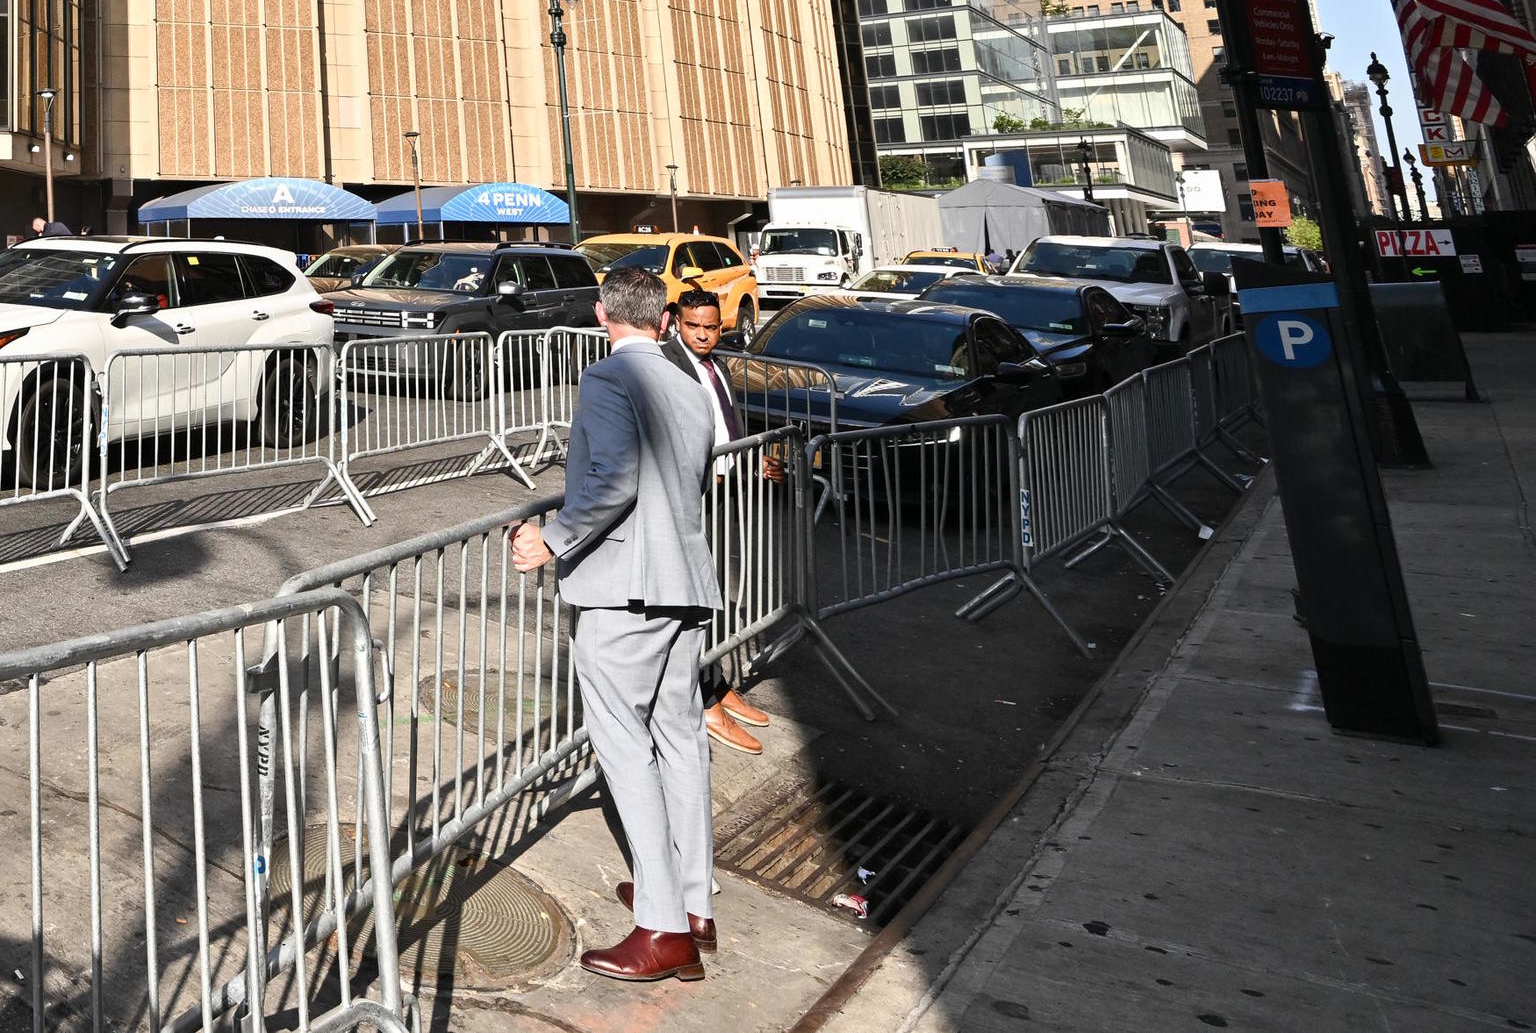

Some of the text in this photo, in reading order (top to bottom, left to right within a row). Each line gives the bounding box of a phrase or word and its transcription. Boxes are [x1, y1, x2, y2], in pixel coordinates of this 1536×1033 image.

[1253, 7, 1290, 18] Commercial
[273, 183, 295, 203] A
[477, 192, 542, 207] 4 PENN
[277, 206, 326, 214] ENTRANCE
[496, 208, 524, 216] WEST
[1377, 230, 1441, 256] PIZZA
[1277, 320, 1314, 360] P
[1021, 491, 1032, 544] NYPD
